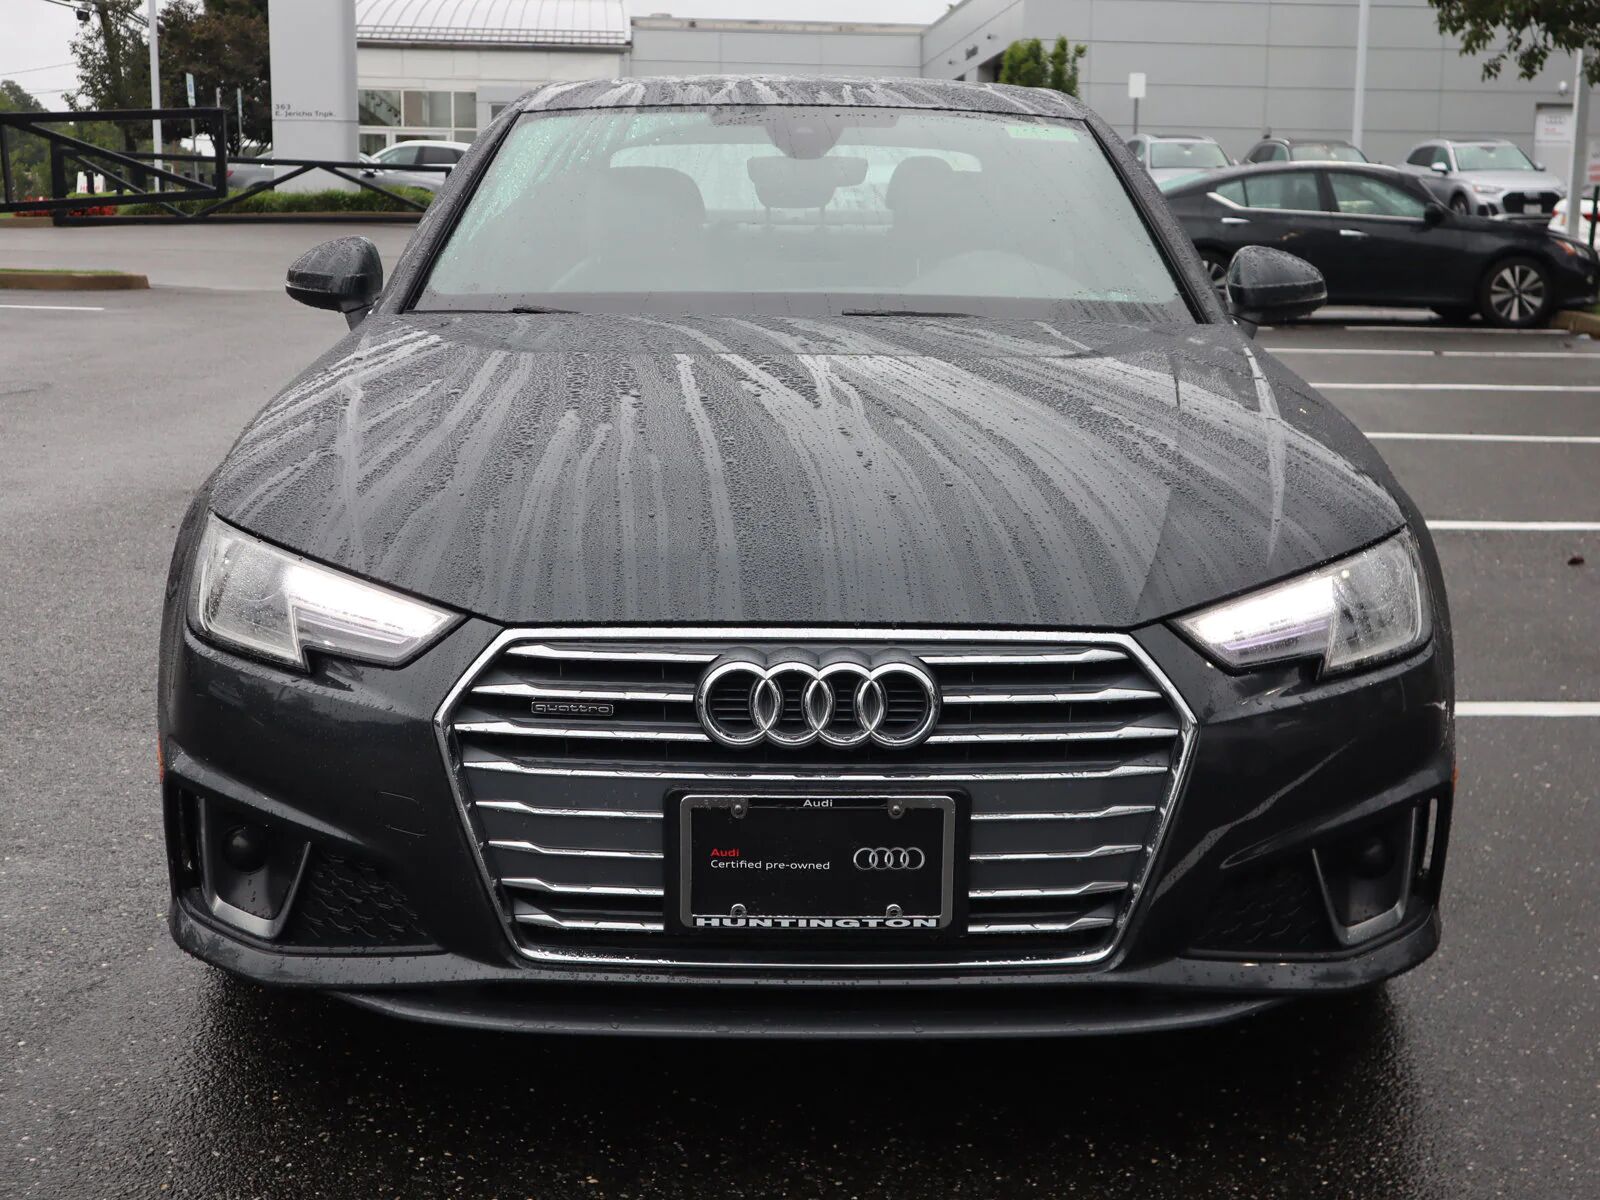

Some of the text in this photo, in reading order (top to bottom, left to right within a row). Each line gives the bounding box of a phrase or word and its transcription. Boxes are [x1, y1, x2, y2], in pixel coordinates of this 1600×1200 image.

[284, 110, 313, 118] Jericho
[535, 704, 610, 713] quattro
[803, 798, 833, 807] Audi
[710, 848, 740, 857] Audi
[710, 859, 831, 872] Certified pre-owned
[696, 917, 937, 928] HUNTINGTON
